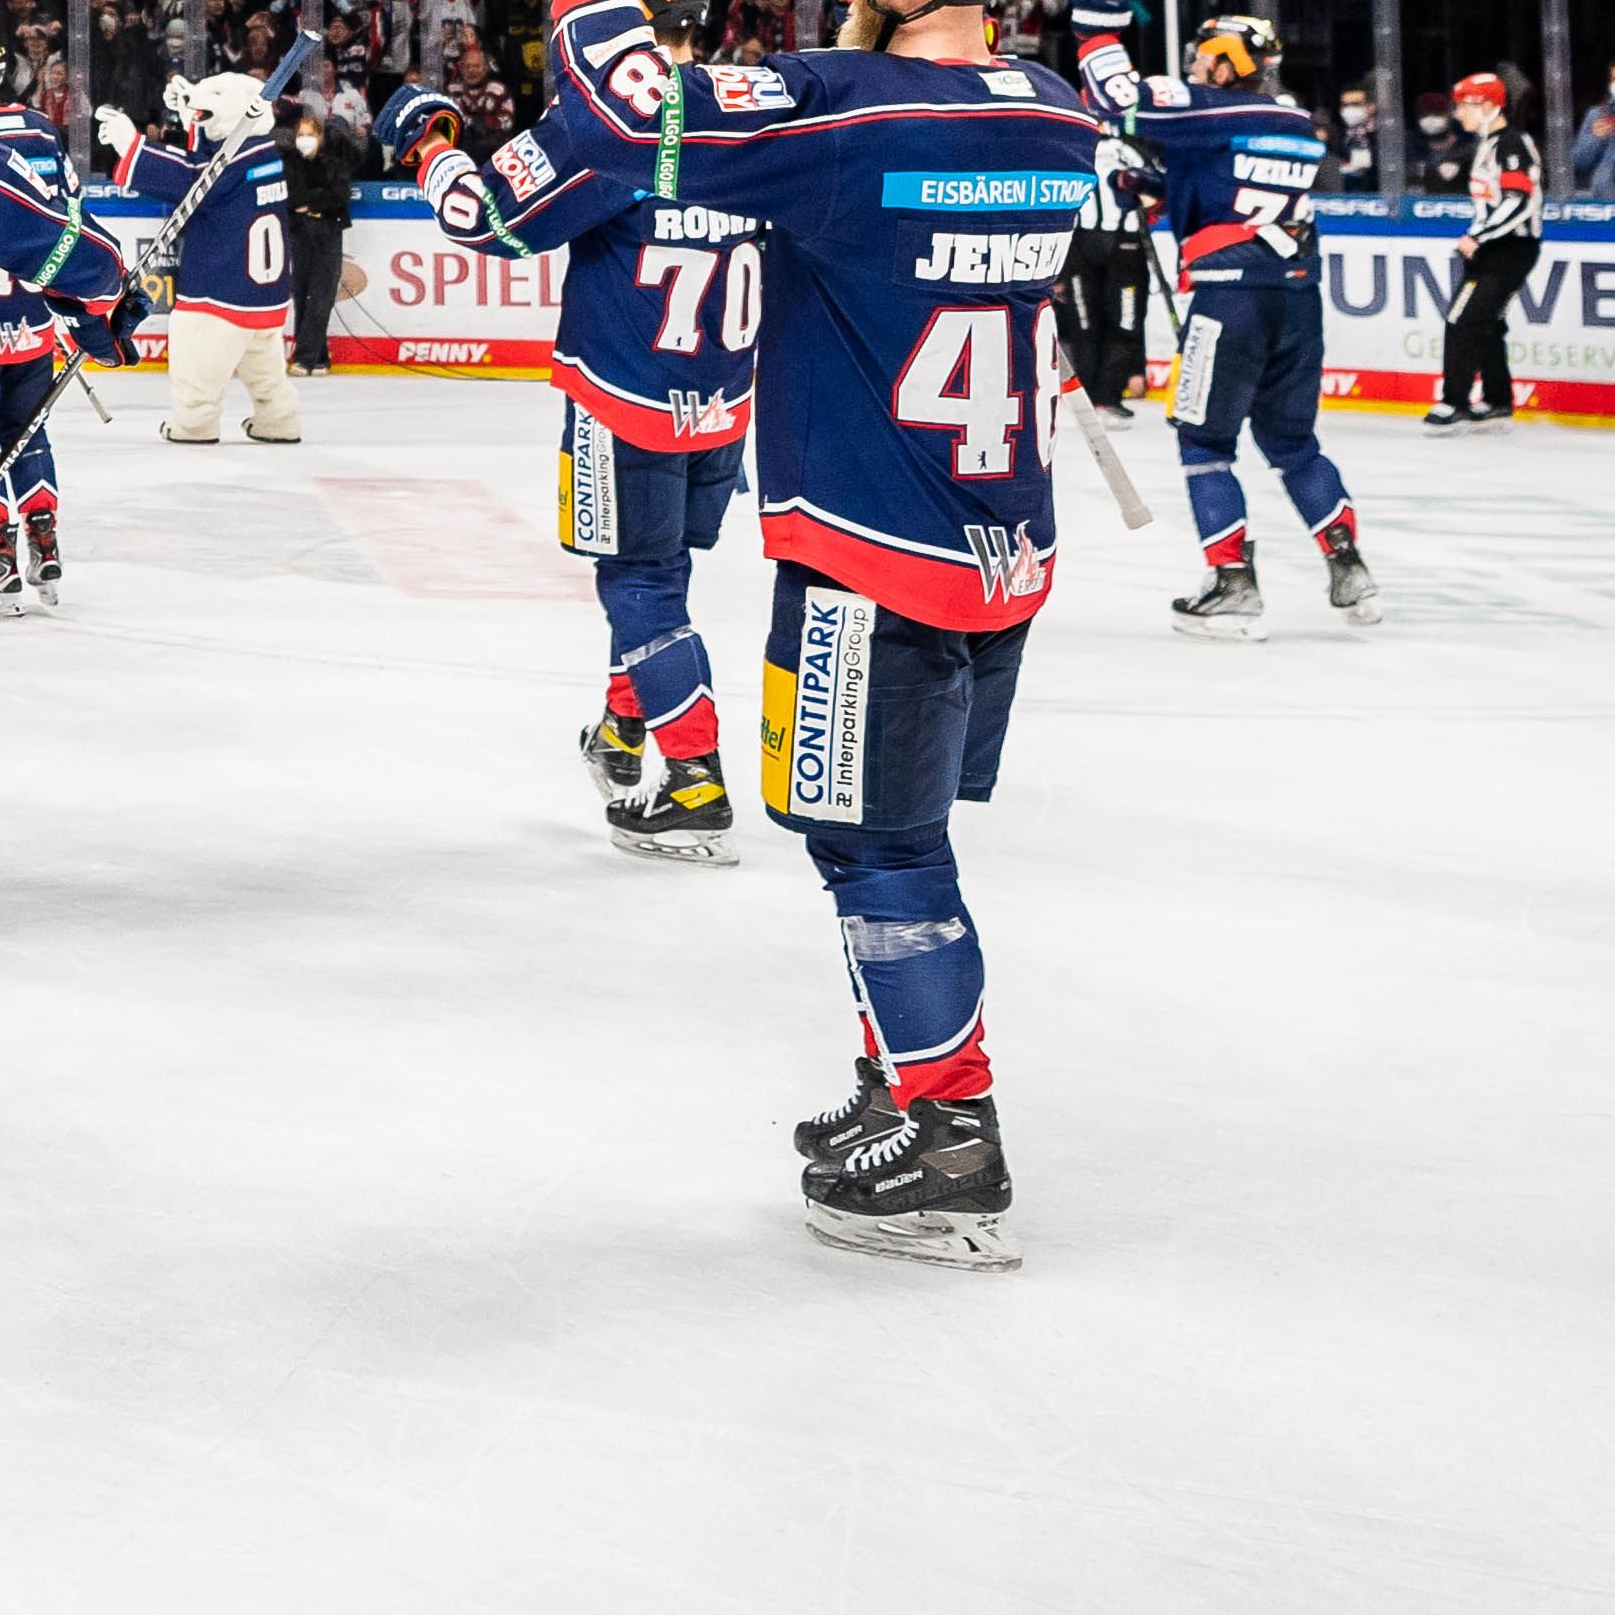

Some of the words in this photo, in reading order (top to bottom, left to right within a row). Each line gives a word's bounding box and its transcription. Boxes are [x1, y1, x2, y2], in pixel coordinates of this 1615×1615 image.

[662, 109, 680, 146] LIGO
[921, 175, 1026, 206] EISBÄREN
[37, 264, 56, 286] LIGO
[55, 234, 74, 263] LIGO
[247, 213, 286, 285] 0
[635, 241, 762, 357] 70
[398, 341, 492, 364] PENNY.
[795, 600, 841, 806] CONTIPARK
[874, 1169, 923, 1195] BAUER
